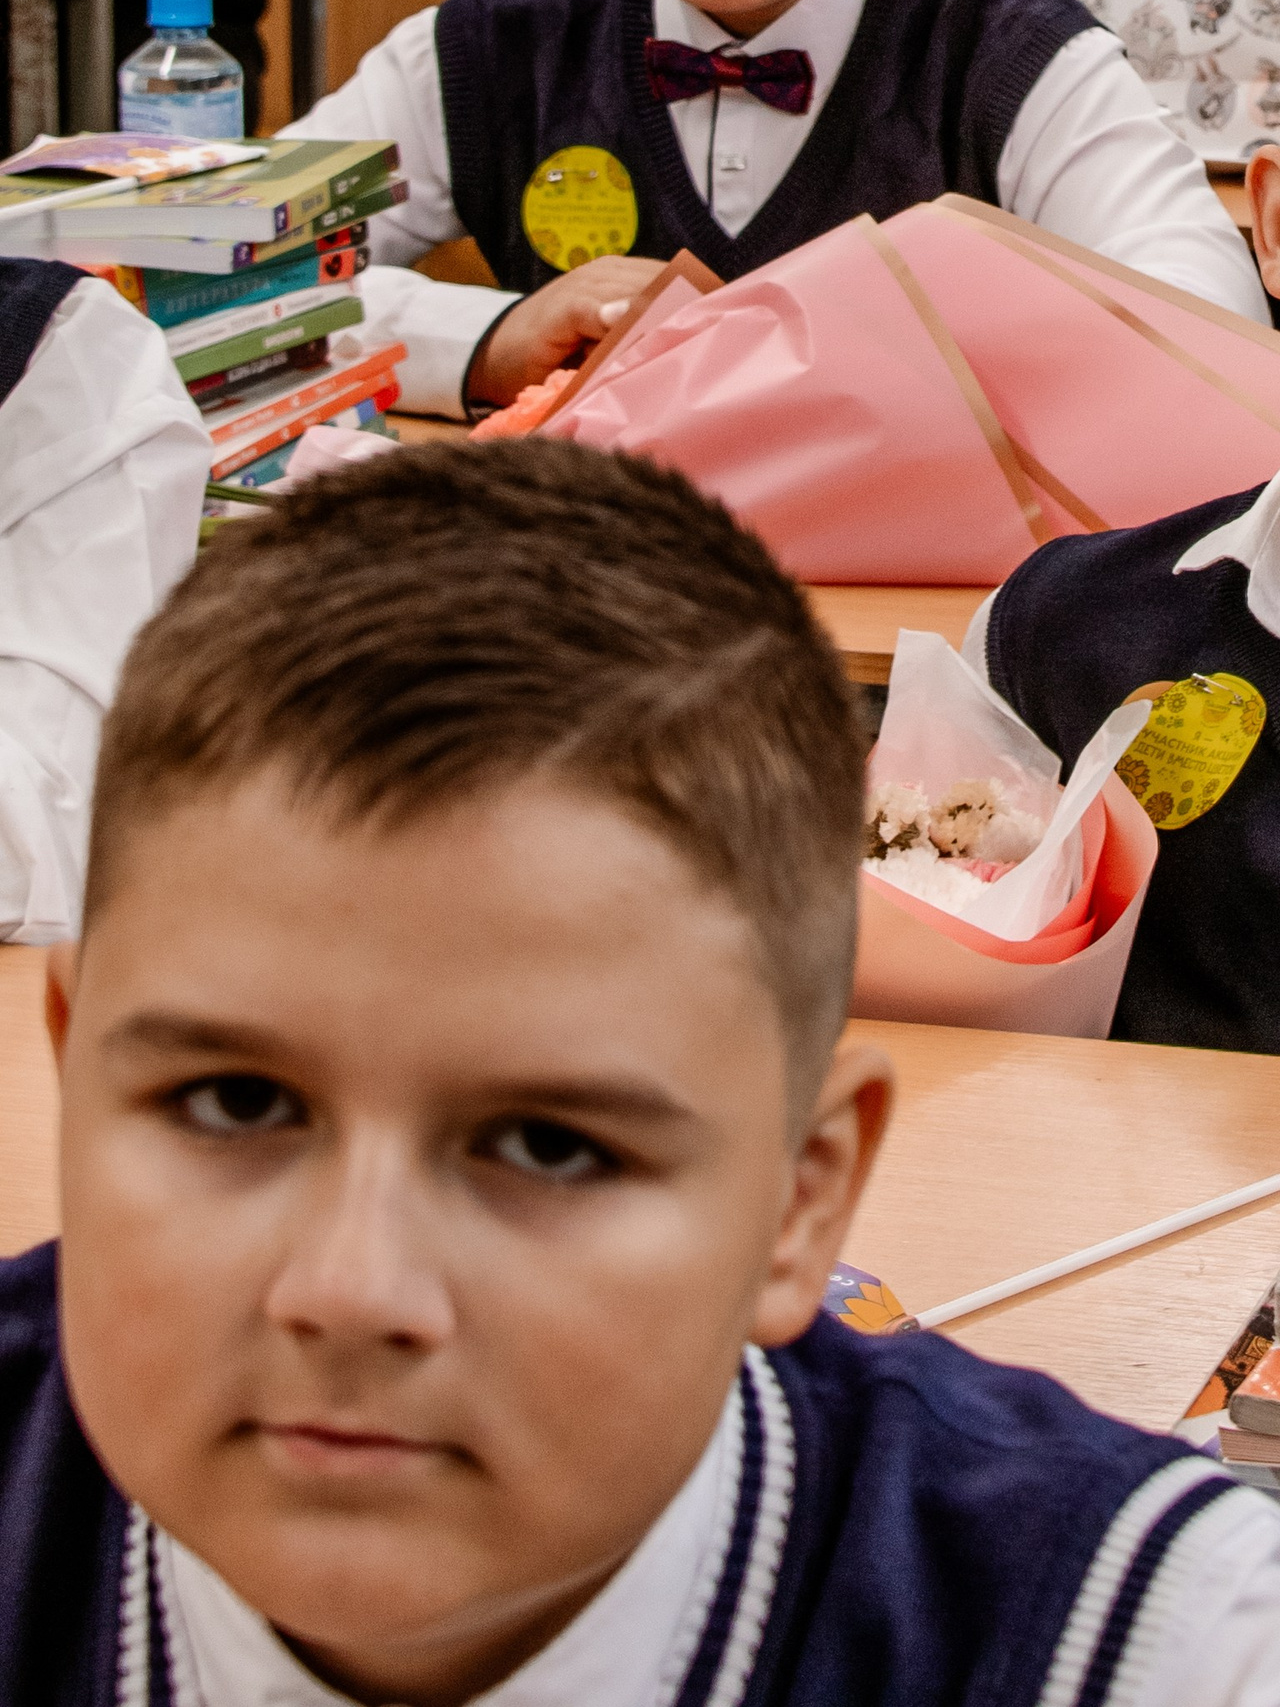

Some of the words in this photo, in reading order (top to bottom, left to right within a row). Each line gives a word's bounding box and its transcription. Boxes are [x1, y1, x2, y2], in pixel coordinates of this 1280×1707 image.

[1133, 741, 1166, 760] ДЕТИ
[1166, 754, 1207, 772] ВМЕСТО
[1141, 728, 1207, 757] УЧАСТНИК
